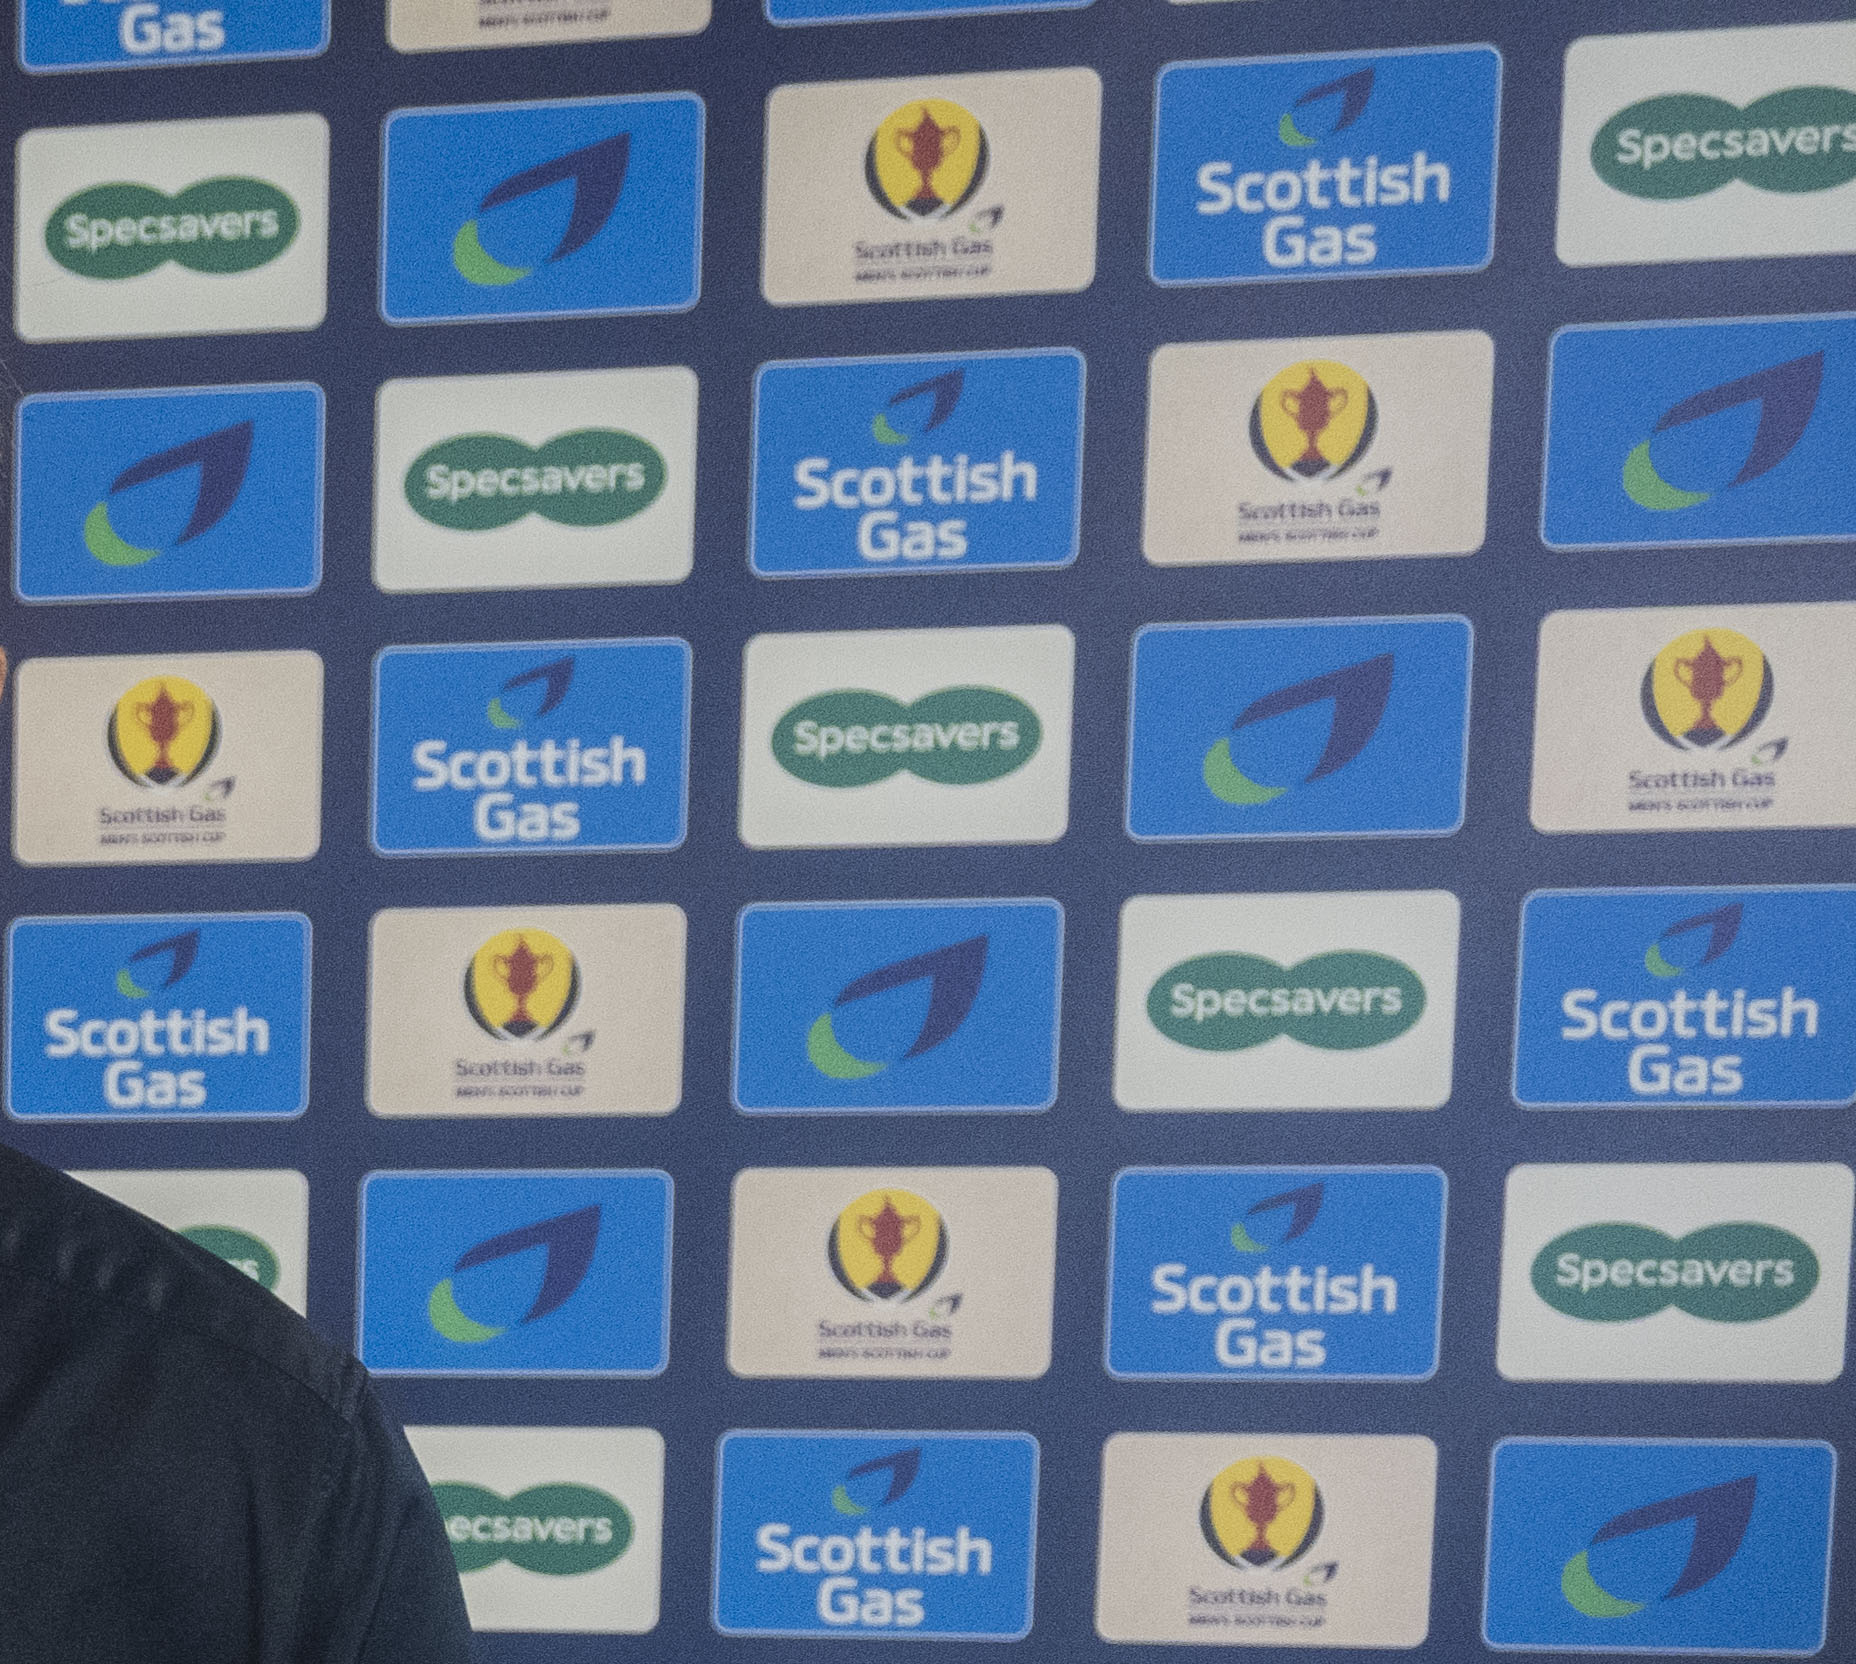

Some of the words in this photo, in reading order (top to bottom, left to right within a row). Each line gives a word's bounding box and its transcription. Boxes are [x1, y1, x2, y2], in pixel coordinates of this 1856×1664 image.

[119, 4, 226, 54] Gas
[1196, 150, 1452, 216] Scottish
[66, 205, 278, 250] Specsavers
[1261, 213, 1378, 267] Gas
[855, 240, 947, 261] Scottish
[427, 462, 645, 501] Specsavers
[794, 449, 1039, 510] Scottish
[856, 508, 969, 559] Gas
[1237, 502, 1331, 521] Scottish
[795, 719, 1019, 758] Specsavers
[412, 735, 647, 791] Scottish
[1628, 771, 1726, 790] Scottish
[1731, 768, 1776, 788] Gas
[99, 808, 187, 825] Scottish
[473, 789, 581, 837] Gas
[1172, 982, 1402, 1021] Specsavers
[1561, 986, 1820, 1041] Scottish
[44, 1005, 271, 1059] Scottish
[103, 1057, 208, 1102] Gas
[455, 1060, 539, 1077] Scottish
[1627, 1042, 1744, 1090] Gas
[1151, 1262, 1398, 1315] Scottish
[1557, 1252, 1794, 1291] Specsavers
[818, 1320, 908, 1339] Scottish
[1214, 1316, 1327, 1362] Gas
[446, 1515, 613, 1544] ecsavers
[756, 1522, 993, 1576] Scottish
[816, 1574, 926, 1622] Gas
[1189, 1585, 1280, 1606] Scottish
